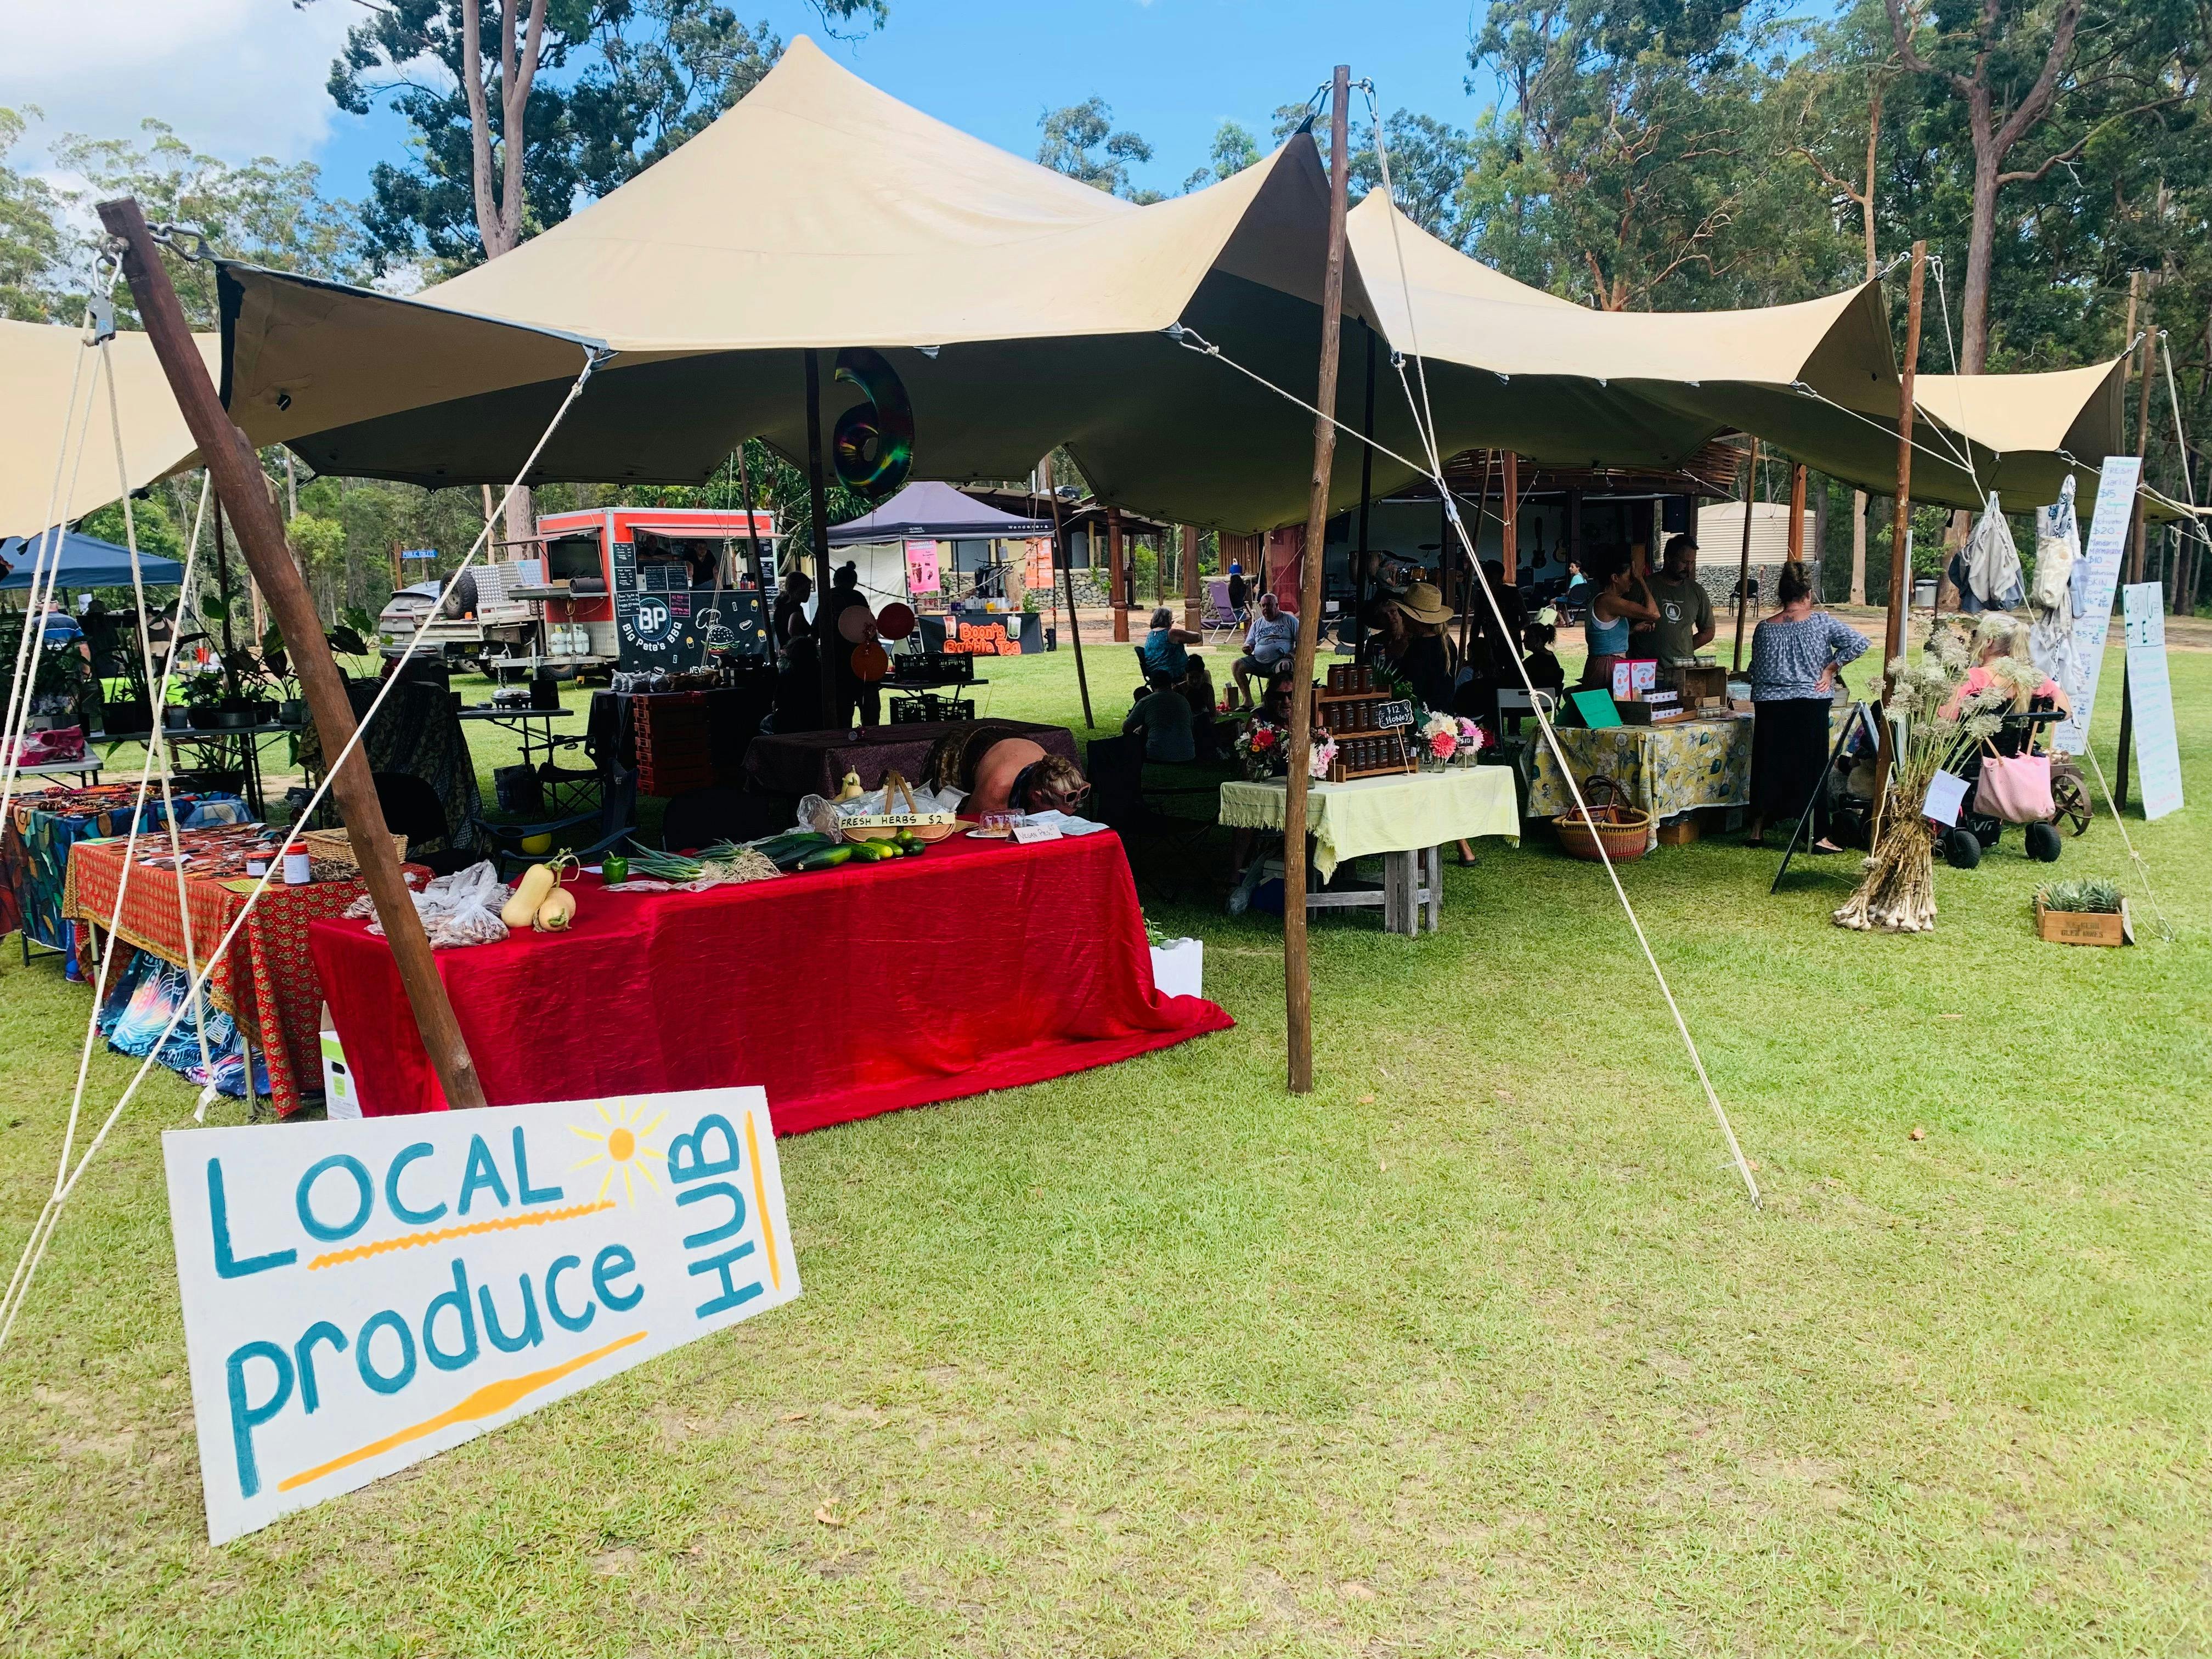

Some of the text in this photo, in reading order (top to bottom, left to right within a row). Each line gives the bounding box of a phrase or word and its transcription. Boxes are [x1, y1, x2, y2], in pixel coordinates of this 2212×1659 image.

[2099, 488, 2116, 498] $15
[639, 607, 667, 630] BP
[635, 637, 666, 652] Pete's
[667, 622, 682, 644] BBQ
[960, 622, 1006, 640] Boon's
[944, 639, 1022, 656] Bubble Tea
[1387, 705, 1400, 714] $12
[841, 814, 944, 827] FRESH HERBS $2
[207, 1113, 765, 1319] LOCAL HUB
[225, 1244, 645, 1500] produce
